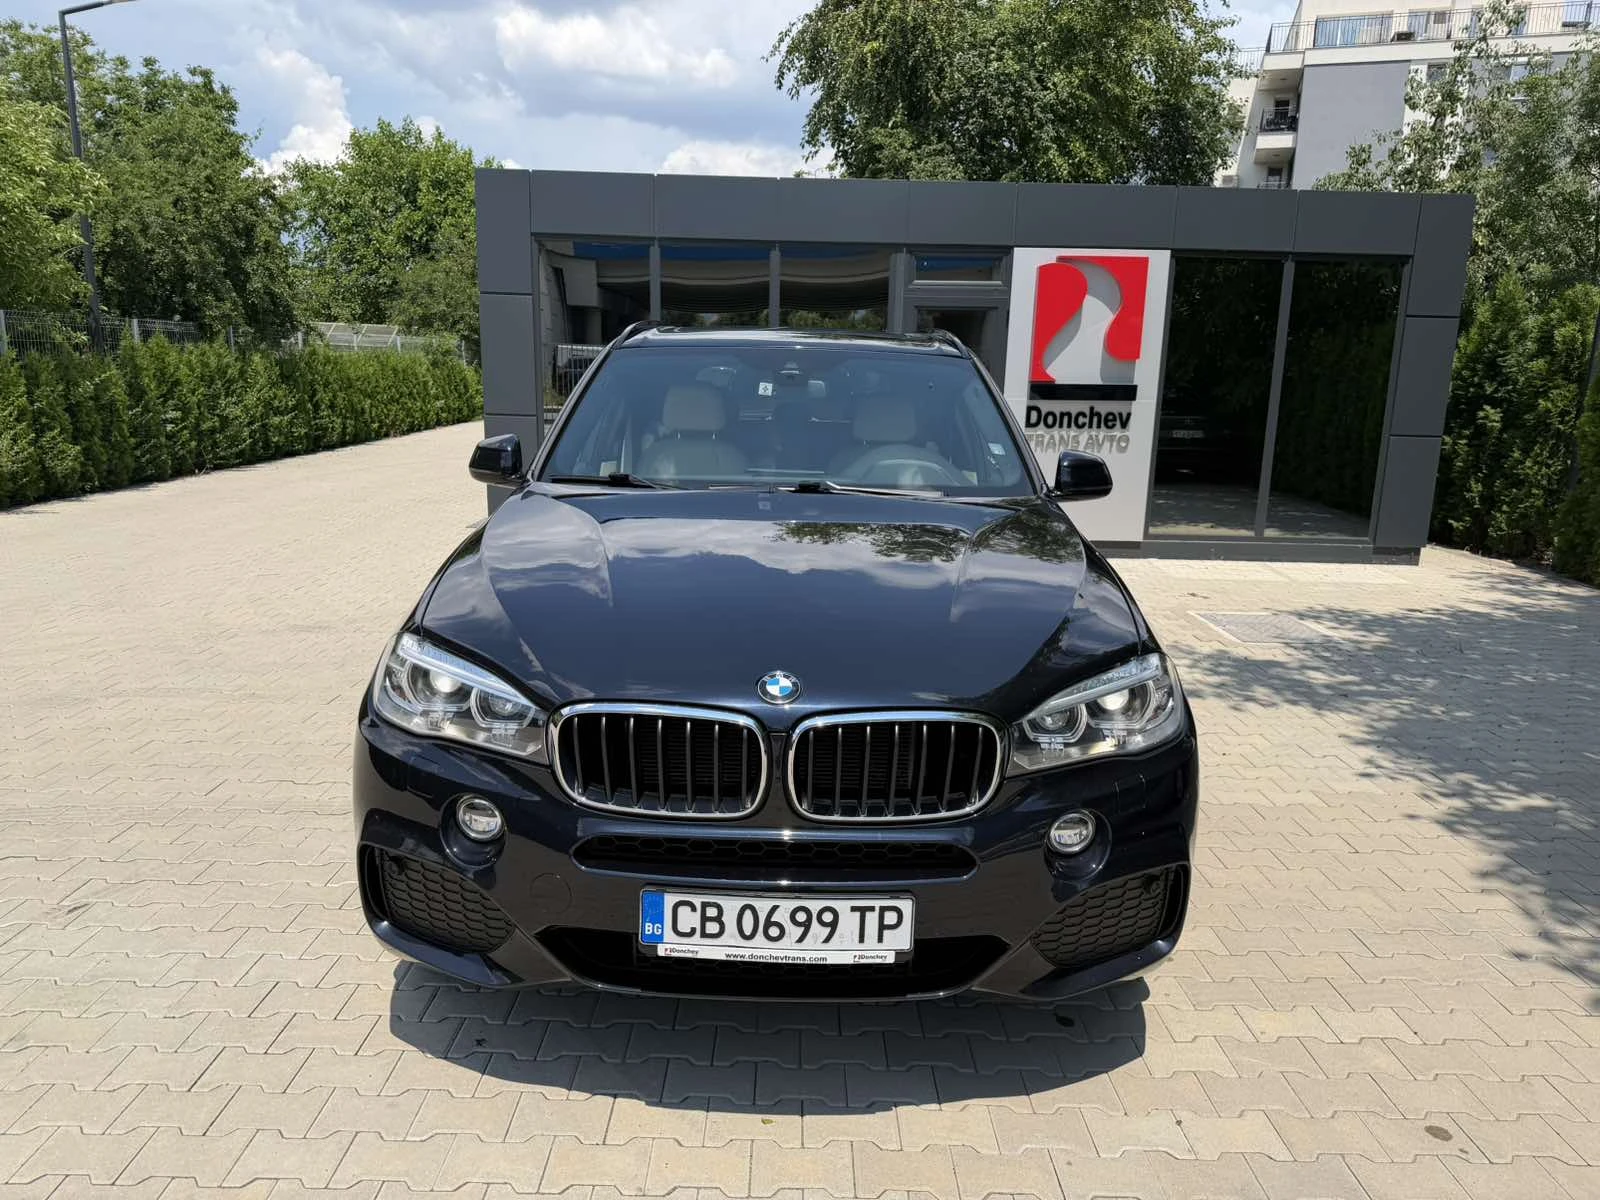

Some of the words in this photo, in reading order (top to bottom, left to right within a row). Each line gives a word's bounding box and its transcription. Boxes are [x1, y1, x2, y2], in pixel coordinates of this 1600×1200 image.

[1025, 405, 1132, 429] Donchev
[1025, 431, 1081, 451] TRANS
[1083, 431, 1130, 453] AVTO
[645, 923, 662, 934] BG
[671, 900, 726, 939] CB
[736, 903, 840, 943] 0699
[850, 906, 903, 944] TP
[725, 952, 828, 963] www.donchevtrans.com
